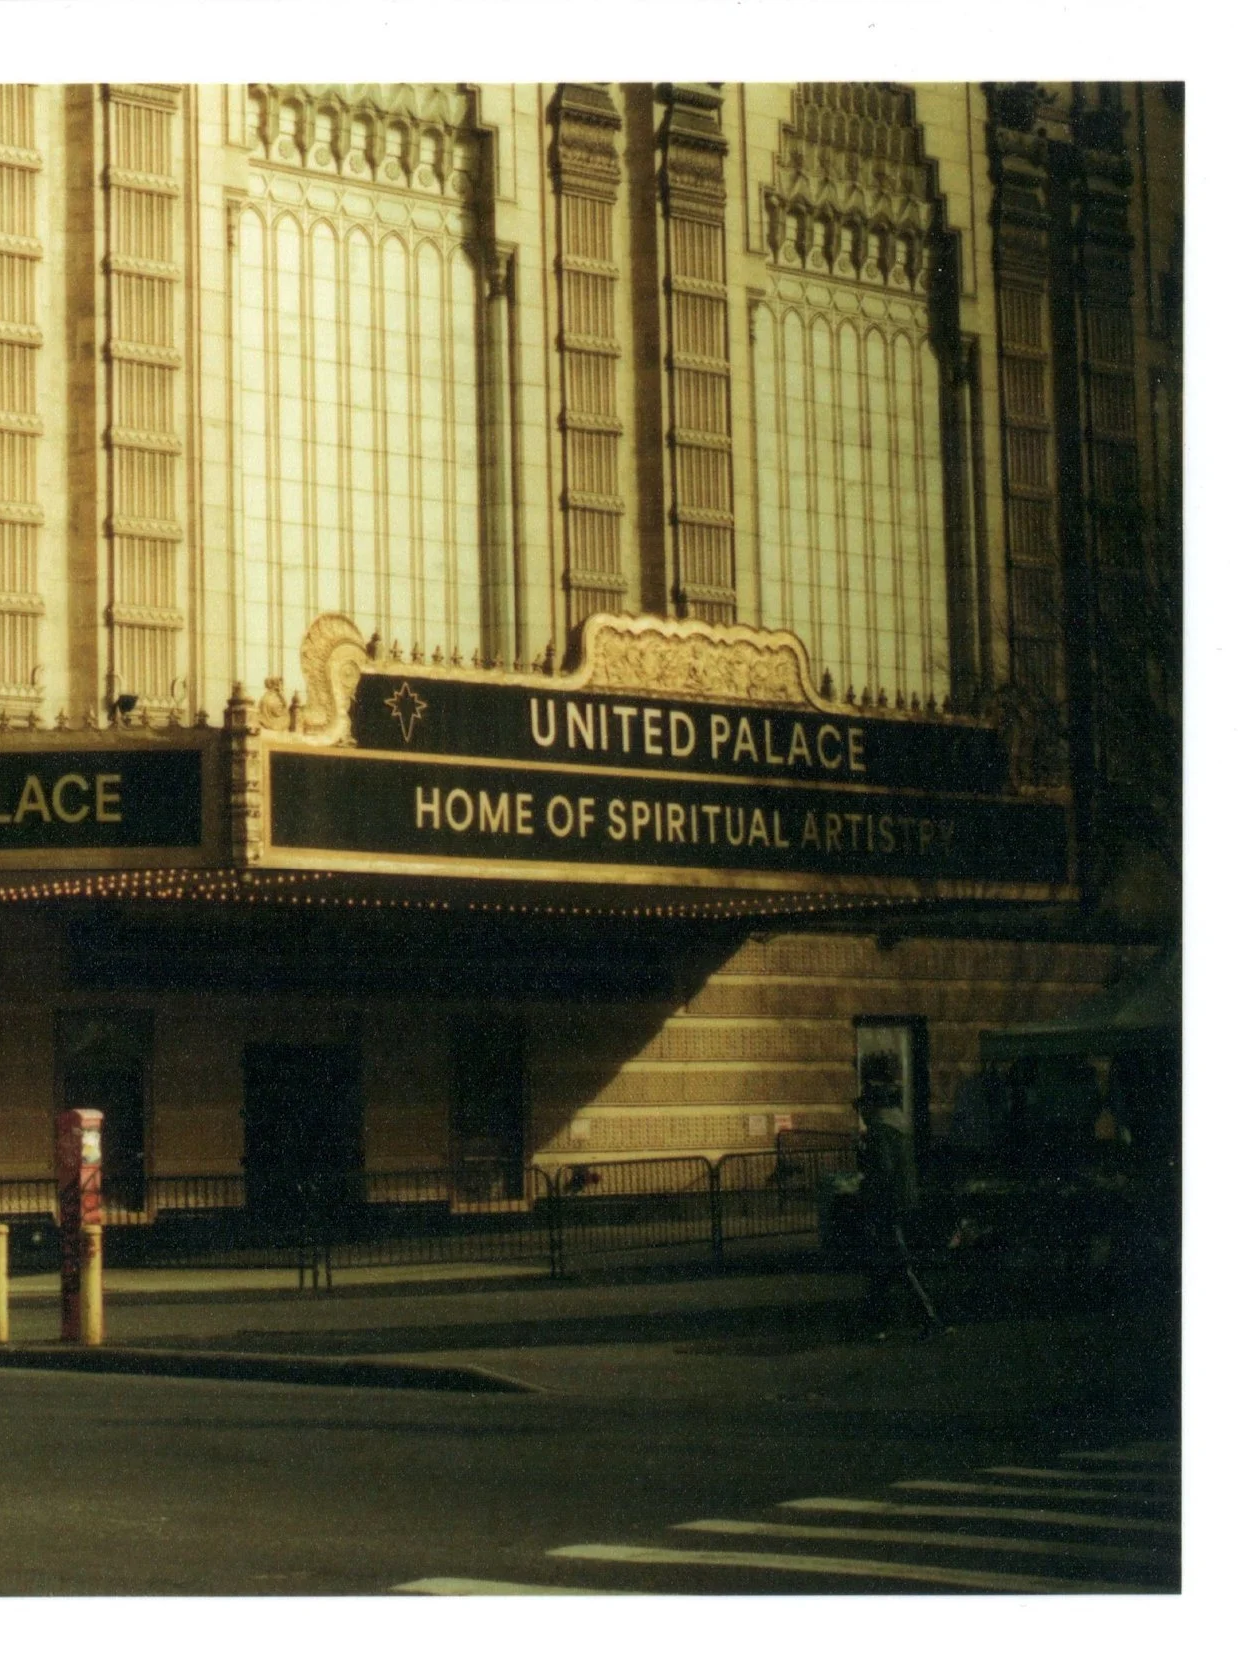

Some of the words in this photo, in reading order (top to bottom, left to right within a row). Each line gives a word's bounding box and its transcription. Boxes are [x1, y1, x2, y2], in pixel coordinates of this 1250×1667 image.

[530, 698, 696, 758] UNITED
[710, 713, 867, 772] PALACE
[415, 787, 534, 834] HOME
[547, 793, 595, 838] OF
[608, 799, 789, 849] SPIRITUAL
[801, 811, 955, 857] ARTISTRY
